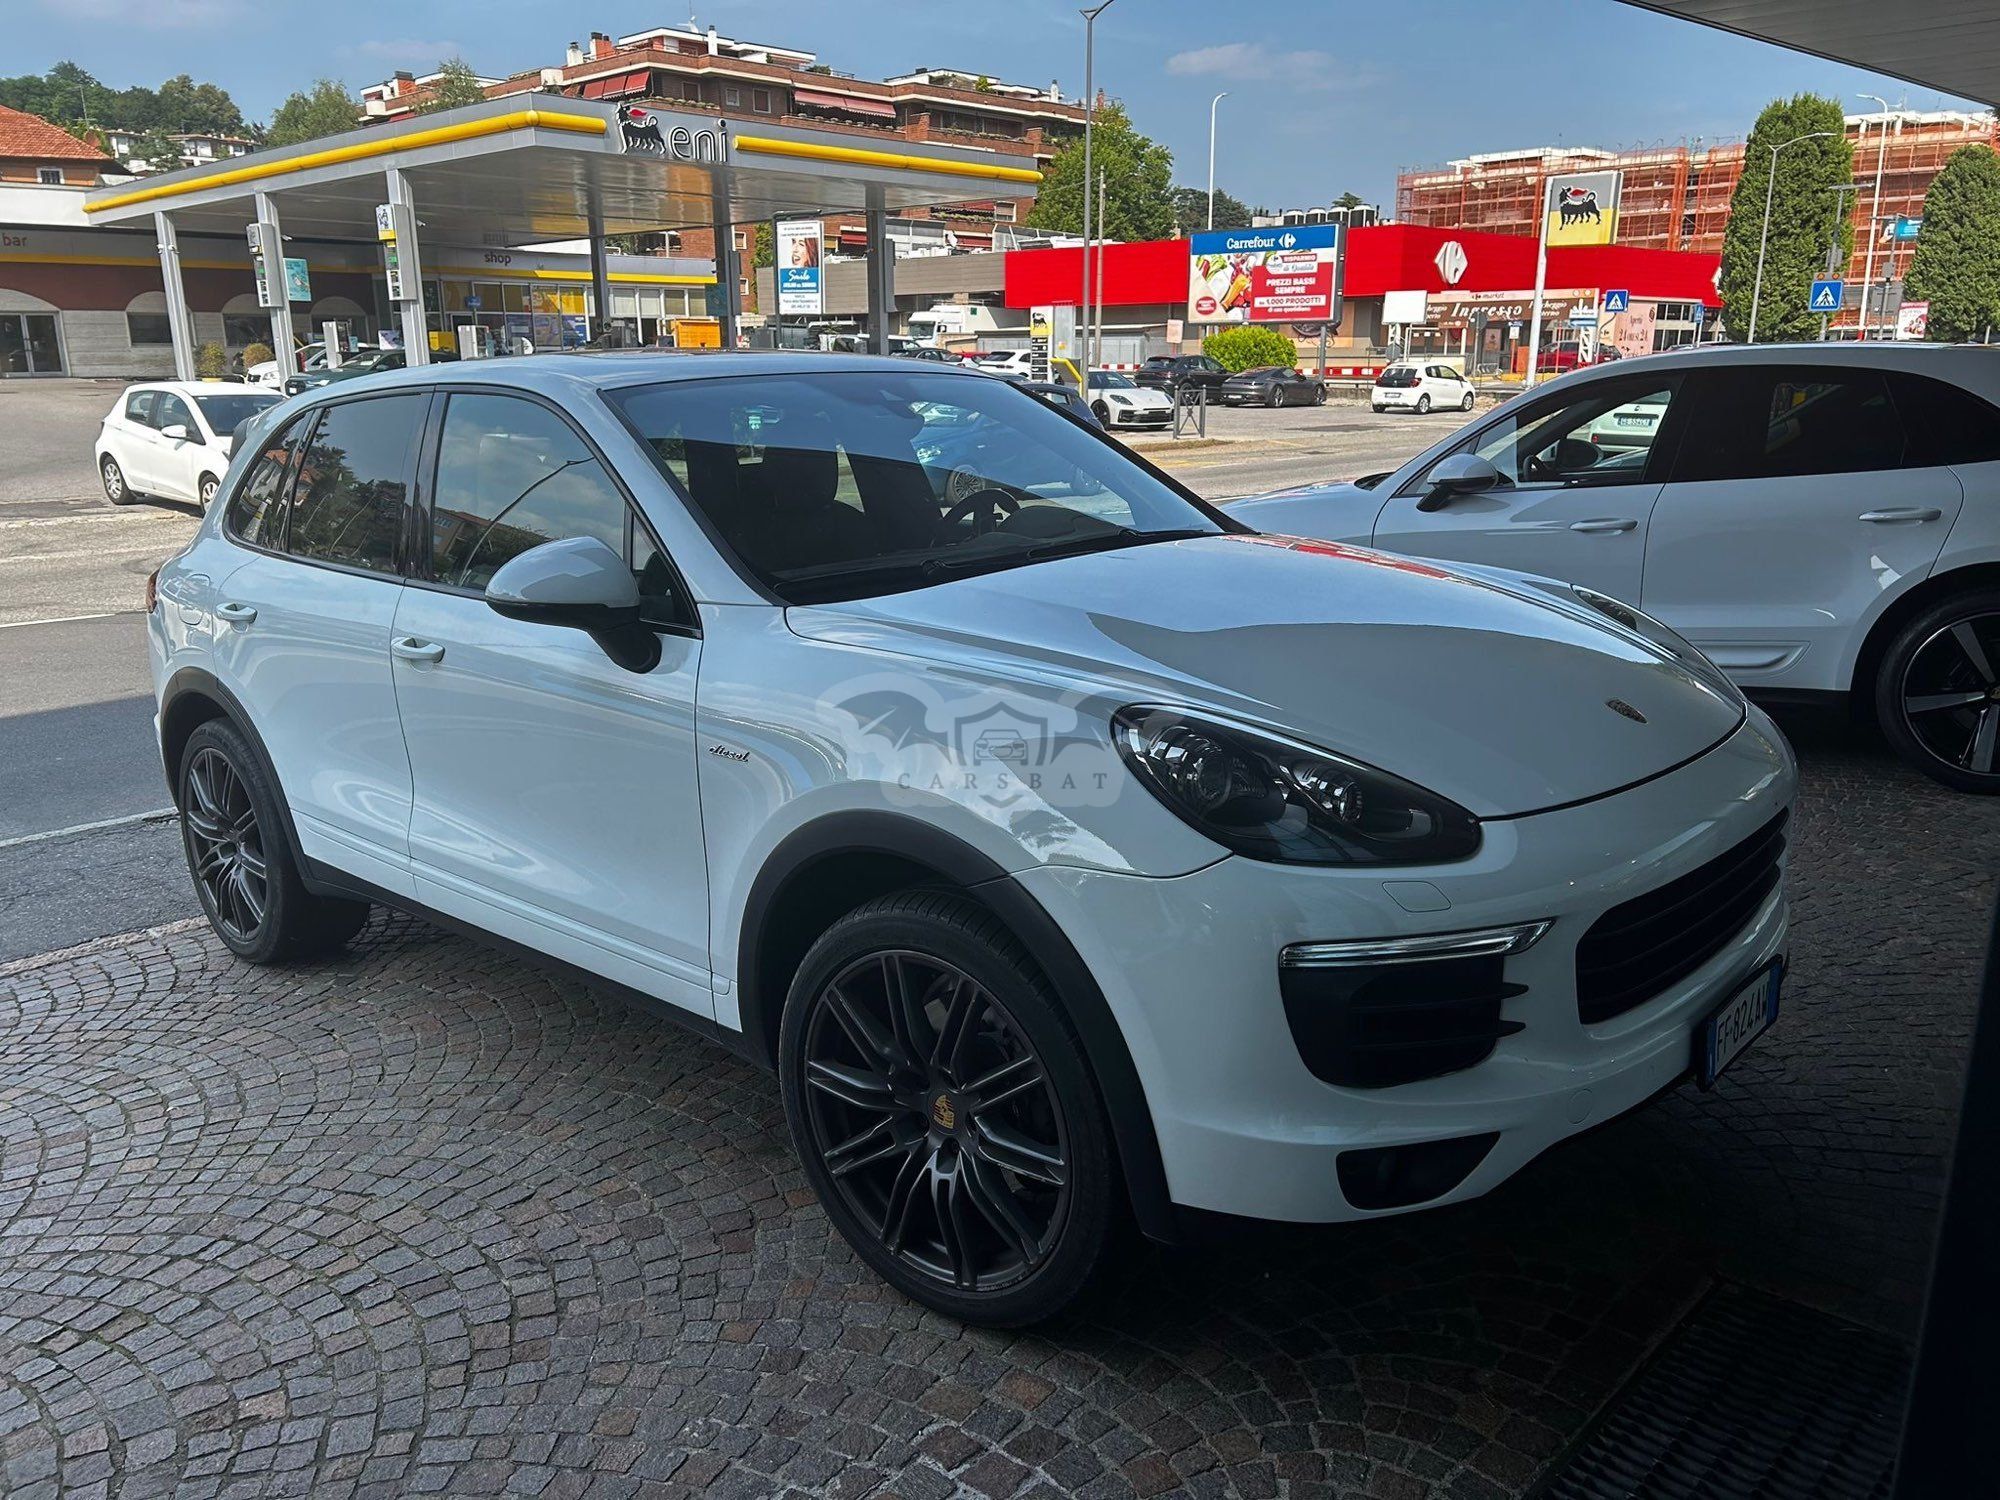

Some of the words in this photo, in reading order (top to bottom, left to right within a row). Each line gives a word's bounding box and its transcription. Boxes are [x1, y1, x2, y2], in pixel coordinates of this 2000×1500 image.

[668, 118, 728, 162] eni
[2, 233, 27, 246] bar
[1227, 236, 1275, 250] Carrefour
[484, 251, 512, 267] shop
[788, 269, 811, 281] Smile
[1266, 277, 1292, 287] PREZZI
[1293, 277, 1316, 286] BASSI
[1275, 285, 1306, 294] SEMPRE
[1450, 303, 1522, 321] Ingresso
